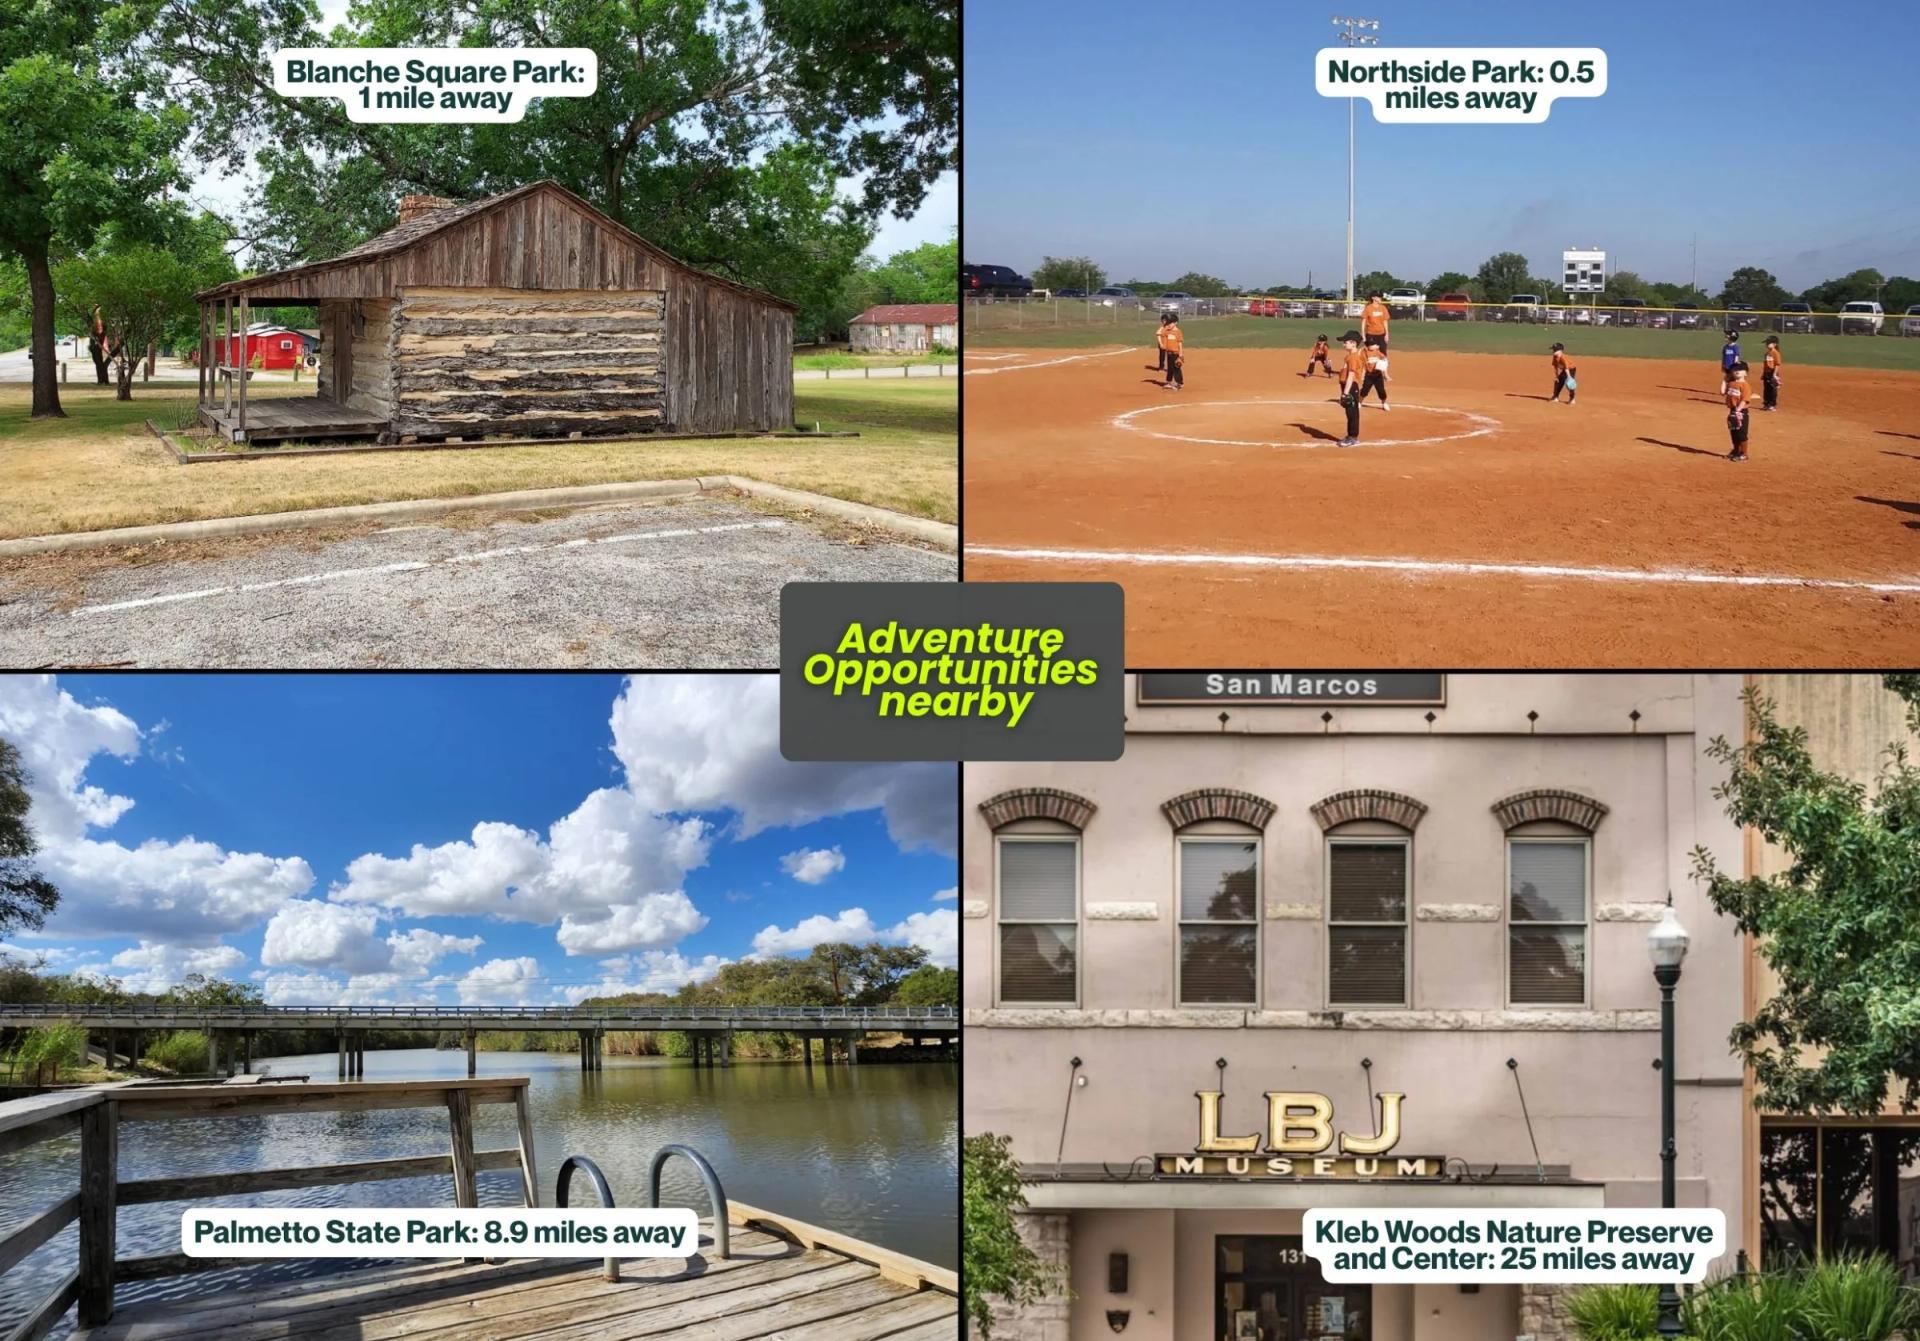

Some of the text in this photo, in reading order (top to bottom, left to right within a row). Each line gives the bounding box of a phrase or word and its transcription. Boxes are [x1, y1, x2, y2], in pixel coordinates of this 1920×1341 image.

[1206, 674, 1378, 695] San Marcos
[1194, 1091, 1406, 1155] LBJ
[1175, 1157, 1428, 1176] MUSEUM
